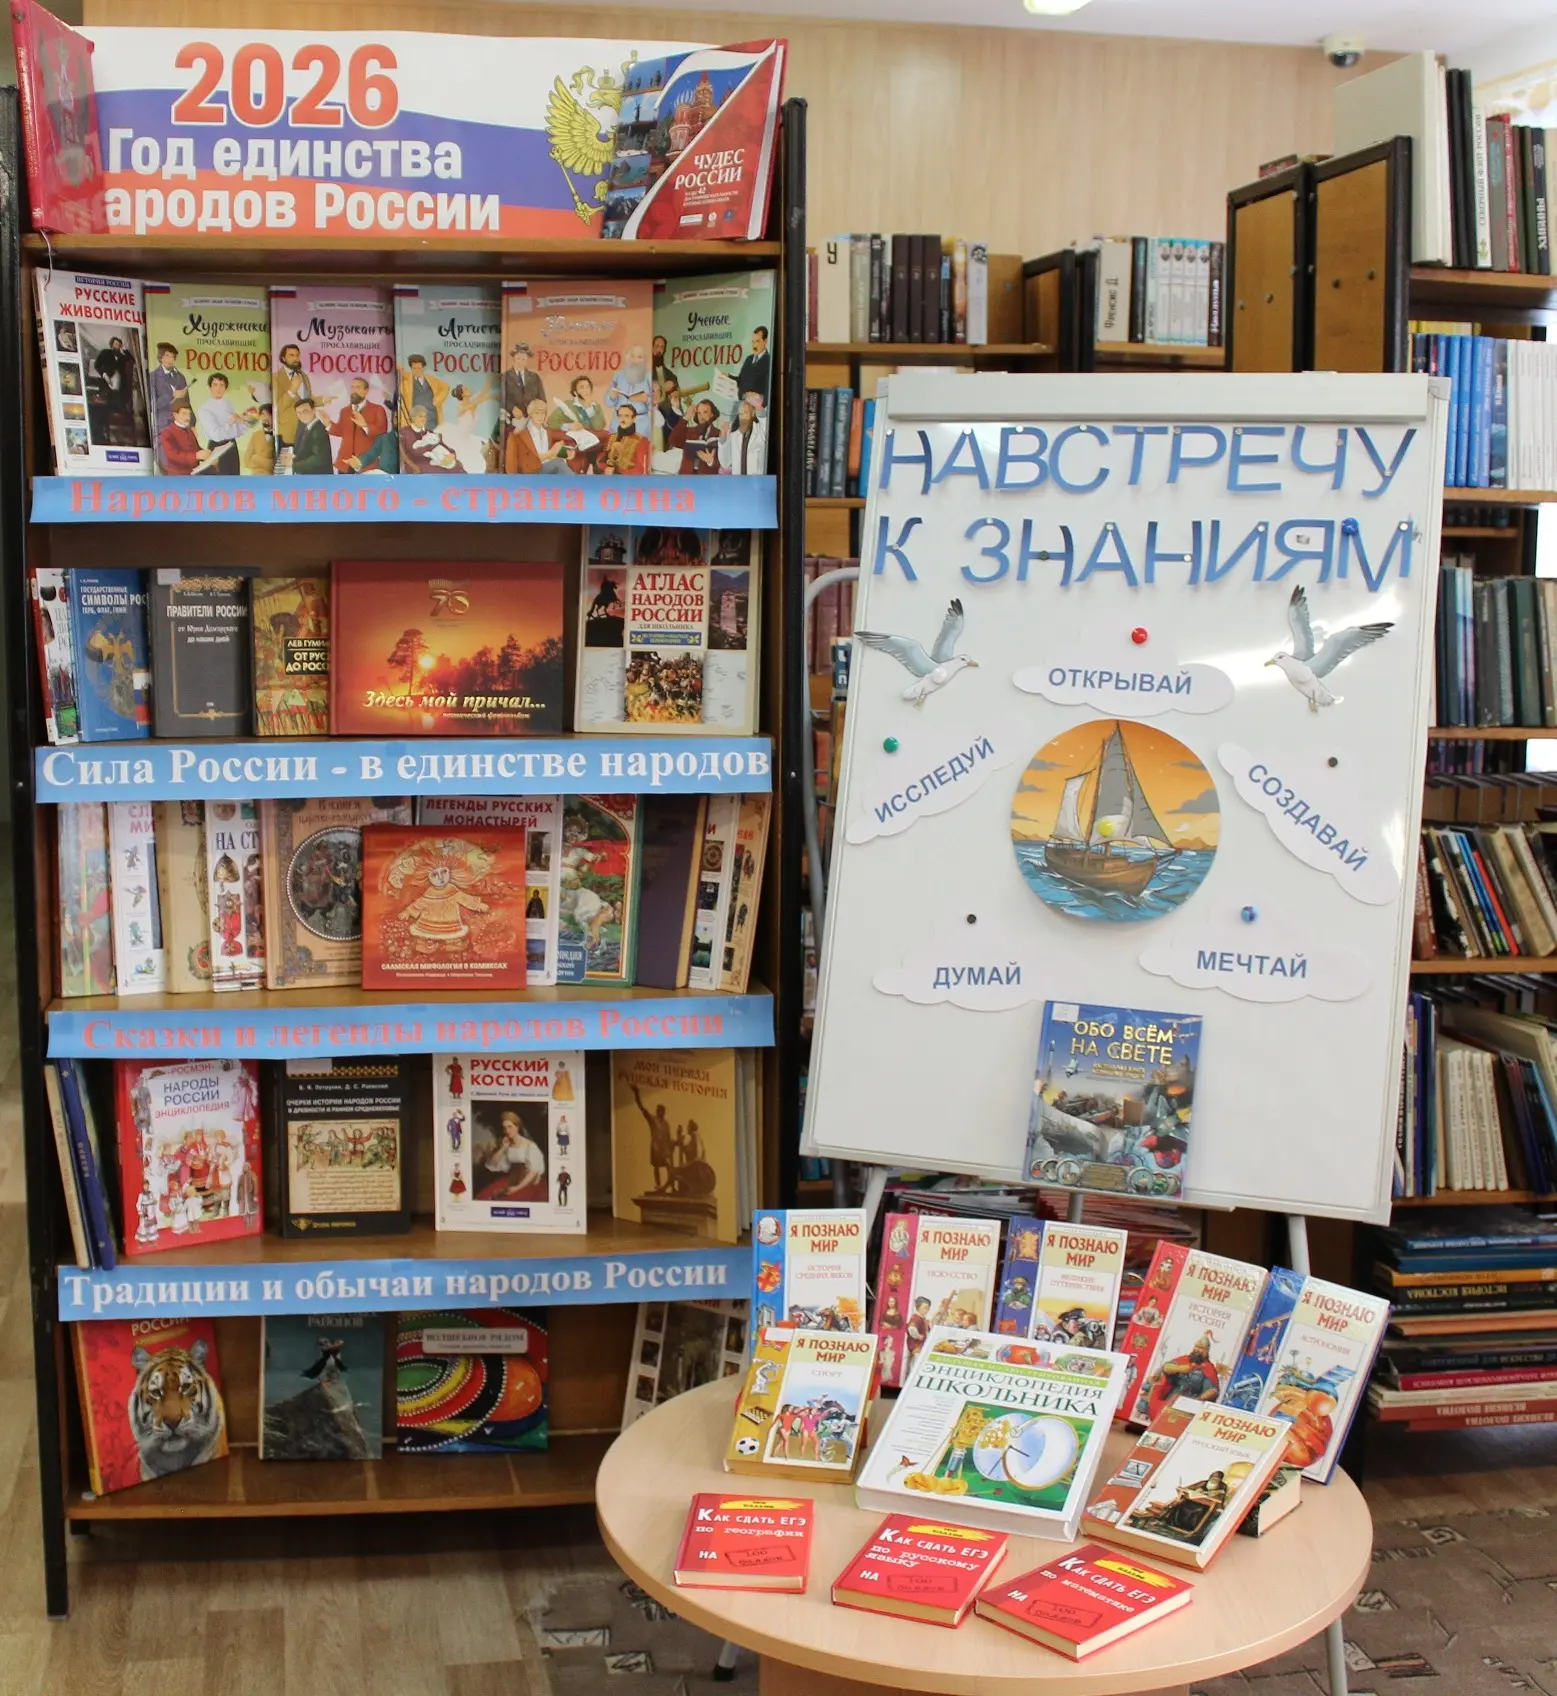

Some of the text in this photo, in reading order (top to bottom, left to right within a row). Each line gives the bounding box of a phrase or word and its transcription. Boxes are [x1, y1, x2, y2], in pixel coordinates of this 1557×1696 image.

[171, 41, 399, 127] 2026
[108, 128, 463, 181] Год единства
[694, 148, 745, 170] ЧУДЕС
[674, 166, 743, 190] РОССИИ
[106, 183, 499, 235] ародов России
[74, 287, 135, 306] РУССКИЕ
[196, 338, 257, 347] ПРОСЛАВИВШИЕ
[321, 341, 381, 350] ПРОСЛАВИВШИЕ
[185, 349, 270, 371] РОССИЮ
[308, 352, 393, 374] РОССИЮ
[432, 351, 500, 374] РОССИ
[536, 349, 622, 372] РОССИЮ
[670, 343, 743, 369] РОССИЮ
[878, 423, 1418, 498] НАВСТРЕЧУ
[69, 480, 695, 518] Народов много страна одна
[872, 515, 1414, 592] К ЗНАНИЯМ
[80, 585, 128, 595] ГОСУДАРСТВЕННЫЕ
[633, 573, 704, 591] АТЛАС
[81, 593, 127, 607] СИМВОЛЫ
[631, 593, 704, 609] НАРОДОВ
[166, 604, 213, 618] ПРАВИТЕЛИ
[631, 608, 703, 623] РОССИИ
[287, 639, 302, 648] ЛЕВ
[293, 651, 329, 661] ОТ РУС
[285, 661, 301, 673] ДО
[1048, 666, 1193, 696] ОТКРЫВАЙ
[363, 690, 546, 712] Здесь мой причал...
[43, 749, 770, 786] Сила России в единстве народов
[873, 735, 996, 824] ИССЛЕДУЙ
[424, 799, 553, 814] ЛЕГЕНДЫ РУССКИХ
[443, 813, 538, 828] МОНАСТЫРЕЙ
[1247, 763, 1370, 873] СОЗДАВАЙ
[215, 831, 236, 851] НА
[419, 962, 463, 970] МИФОЛОГИЯ
[469, 962, 508, 970] КОМИКСАХ
[1196, 949, 1308, 980] МЕЧТАЙ
[932, 961, 1022, 990] ДУМАЙ
[83, 1009, 724, 1051] Сказки и легенды народов России
[1073, 1020, 1174, 1044] ОБО ВСЁМ
[1070, 1038, 1173, 1066] НА СВЕТЕ
[470, 1057, 549, 1073] РУССКИЙ
[163, 1076, 219, 1094] НАРОДЫ
[470, 1074, 549, 1087] КОСТЮМ
[164, 1090, 220, 1107] РОССИИ
[286, 1096, 401, 1107] ОЧЕРКИ ИСТОРИИ НАРОДОВ РОССИИ
[155, 1101, 230, 1119] ЭНЦИКЛОПЕДИЯ
[790, 1223, 860, 1238] Я ПОЗНАЮ
[920, 1230, 991, 1247] Я ПОЗНАЮ
[810, 1239, 839, 1253] МИР
[1047, 1234, 1119, 1255] Я ПОЗНАЮ
[940, 1247, 969, 1261] МИР
[1065, 1252, 1095, 1267] МИР
[807, 1264, 841, 1272] ИСТОРИЯ
[1186, 1264, 1196, 1277] Я
[64, 1261, 728, 1313] Традиции и обычаи народов России
[1201, 1284, 1231, 1303] МИР
[1188, 1302, 1232, 1320] ИСТОРИЯ
[1301, 1291, 1376, 1324] Я ПОЗНАЮ
[131, 1317, 190, 1337] РОССИ
[1188, 1312, 1227, 1329] РОССИИ
[1316, 1312, 1348, 1332] МИР
[796, 1338, 870, 1353] Я ПОЗНАЮ
[1301, 1334, 1351, 1355] АСТРОНОМИЯ
[815, 1350, 846, 1363] МИР
[811, 1369, 844, 1378] СПОРТ
[921, 1363, 1104, 1399] ЭНЦИКЛОПЕДИЯ
[913, 1375, 1099, 1416] ШКОЛЬНИКА
[1199, 1411, 1276, 1438] Я ПОЗНАЮ
[1213, 1427, 1247, 1443] МИР
[735, 1515, 775, 1525] СДАТЬ
[780, 1516, 806, 1526] ЕГЭ
[723, 1527, 804, 1538] географии
[698, 1550, 717, 1560] НА
[870, 1545, 981, 1571] по русскому
[916, 1539, 957, 1554] СДАТЬ
[960, 1547, 989, 1560] ЕГЭ
[864, 1552, 920, 1568] языку
[859, 1569, 880, 1582] НА
[1007, 1589, 1029, 1602] НА
[1039, 1570, 1136, 1613] по математике
[1089, 1573, 1126, 1594] СДАТЬ
[1126, 1589, 1158, 1605] ЕГЭ
